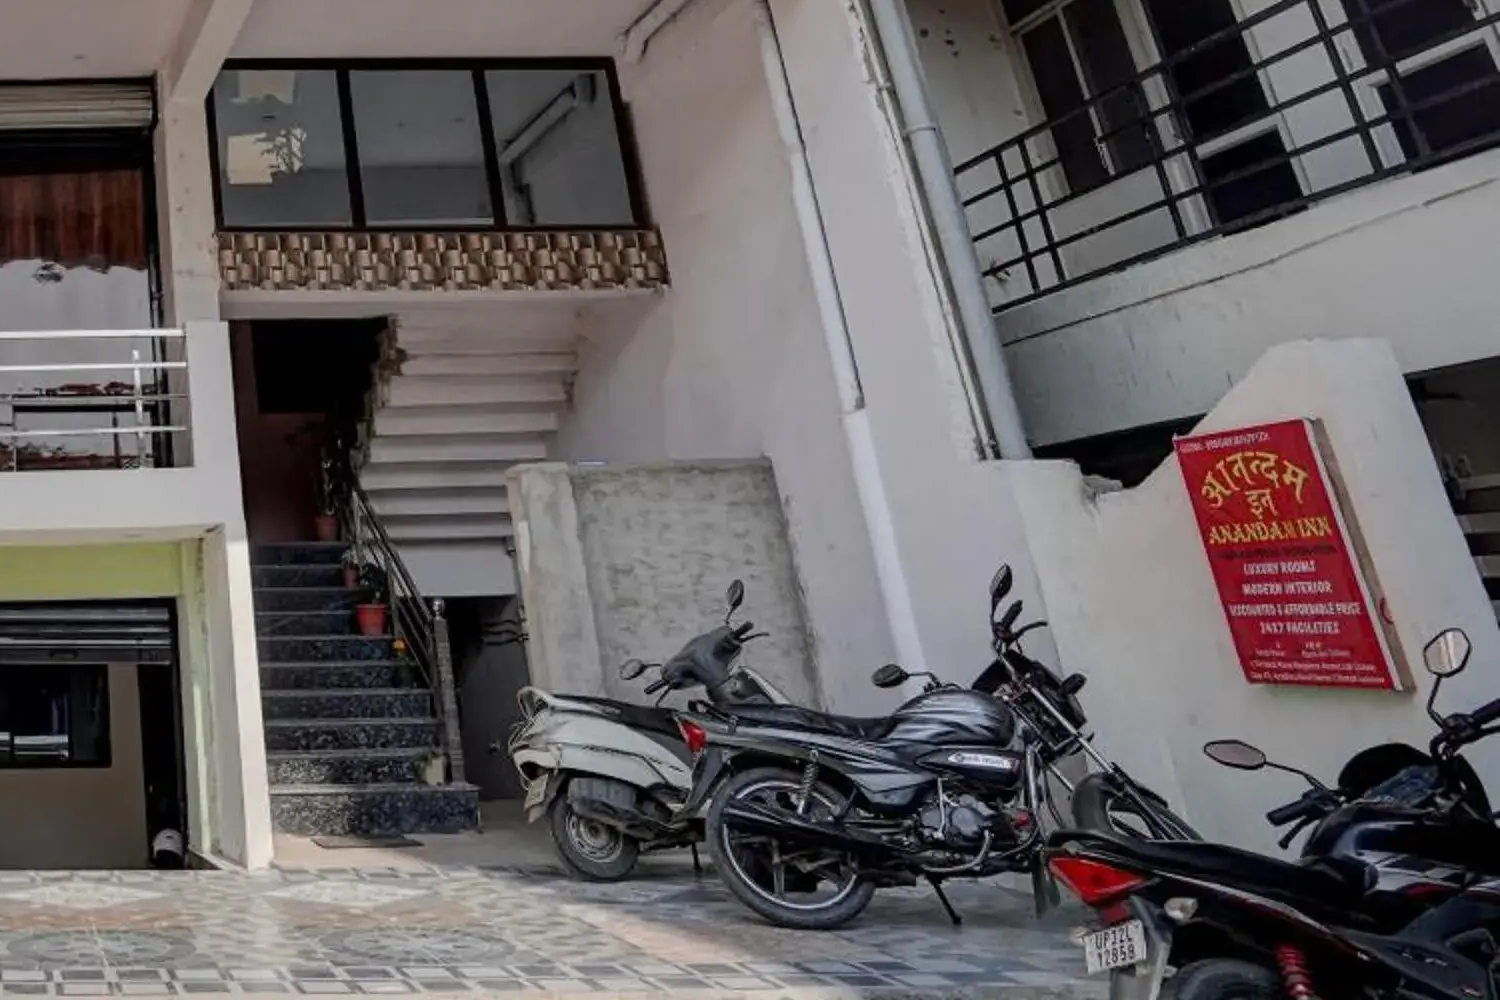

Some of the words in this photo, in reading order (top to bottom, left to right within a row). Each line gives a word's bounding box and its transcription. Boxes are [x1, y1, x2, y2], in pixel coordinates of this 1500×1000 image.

[1209, 520, 1297, 545] ANANDAM
[1297, 516, 1333, 538] INN
[1243, 562, 1278, 575] LUXURY
[1280, 560, 1316, 574] ROOMS
[1242, 582, 1282, 596] MODERN
[1284, 580, 1333, 595] INTERIOR
